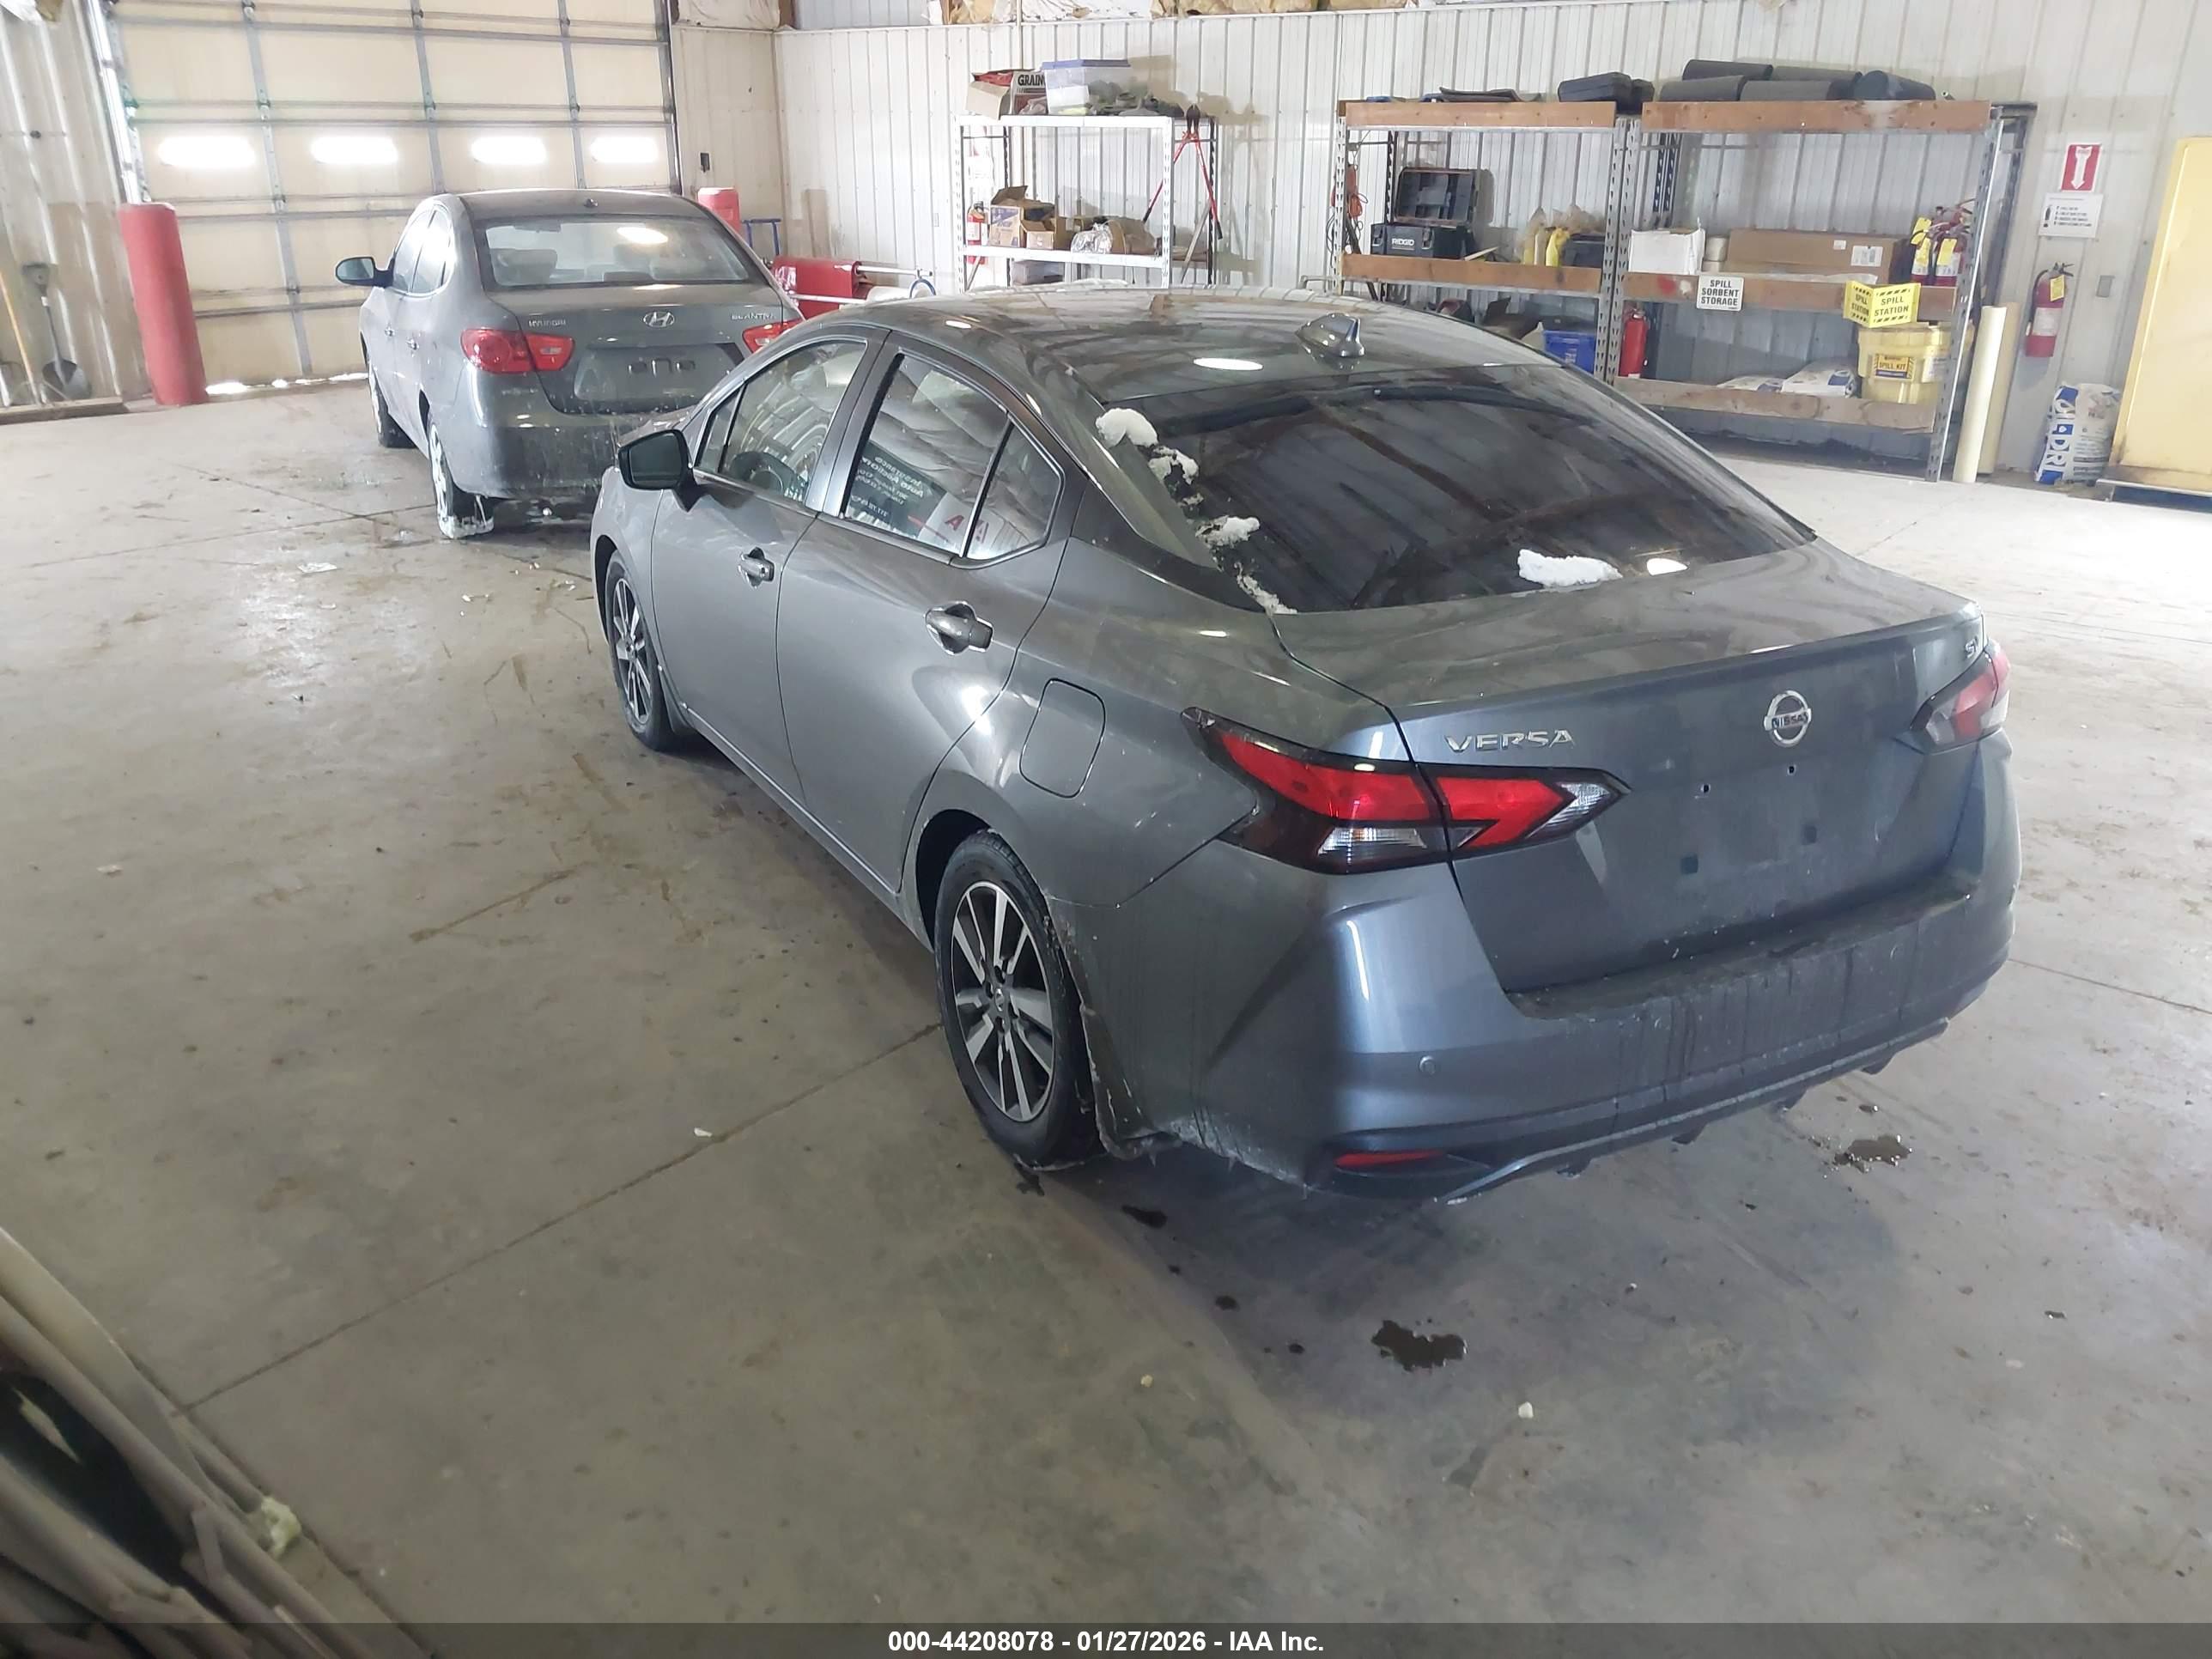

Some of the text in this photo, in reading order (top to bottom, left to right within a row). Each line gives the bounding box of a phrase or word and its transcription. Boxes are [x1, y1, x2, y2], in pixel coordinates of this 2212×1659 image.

[1711, 280, 1732, 289] SPILL
[1701, 288, 1740, 297] SORBENT
[1701, 296, 1738, 306] STORAGE
[1881, 295, 1904, 306] SPILL
[1874, 306, 1909, 316] STATION
[1772, 712, 1809, 729] NISSAN
[1445, 729, 1575, 752] VERSA
